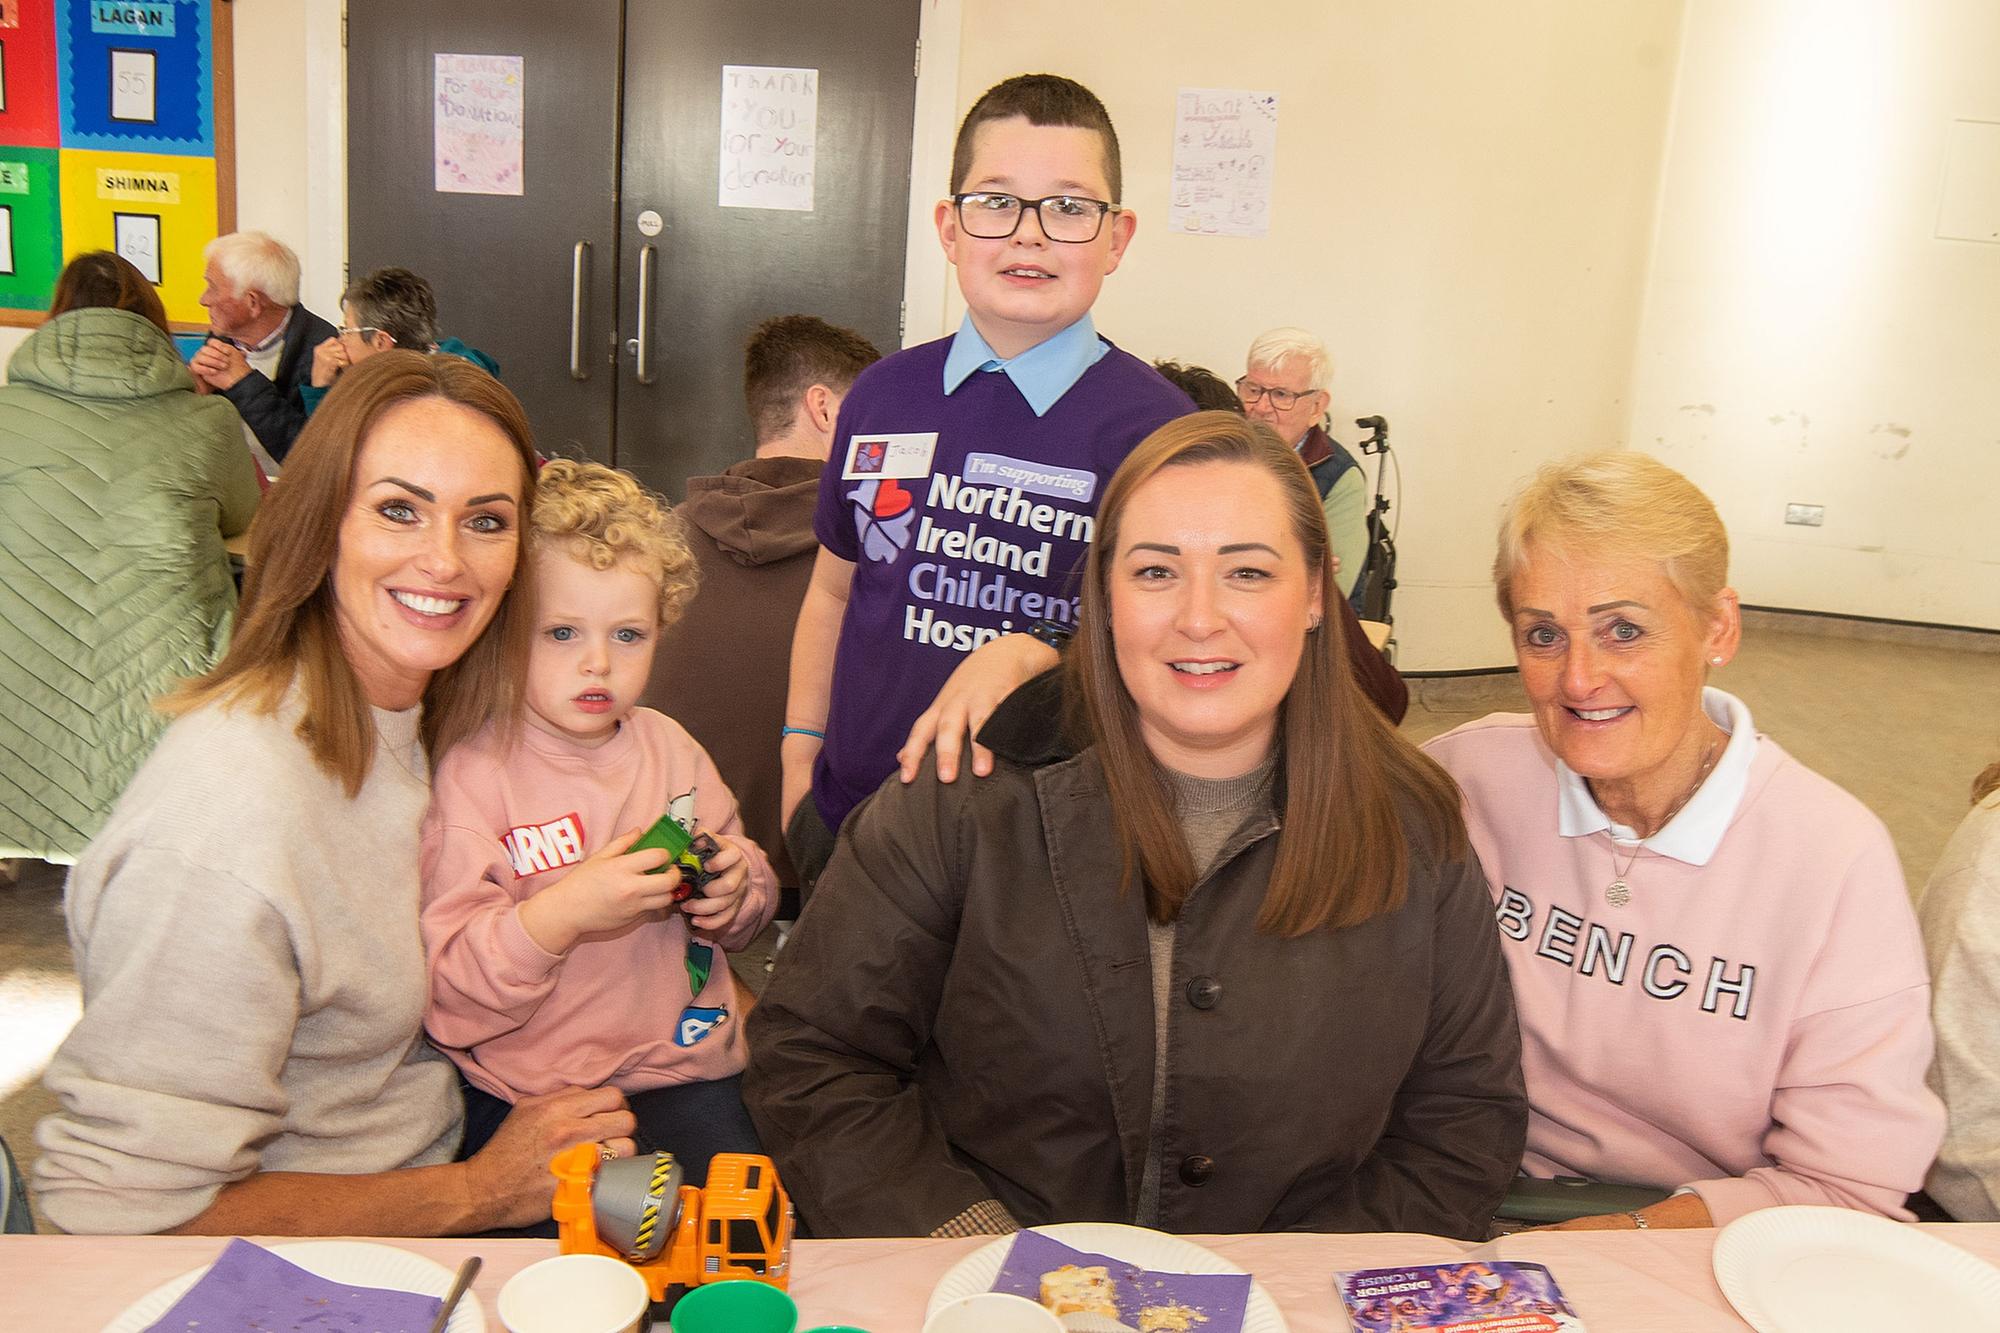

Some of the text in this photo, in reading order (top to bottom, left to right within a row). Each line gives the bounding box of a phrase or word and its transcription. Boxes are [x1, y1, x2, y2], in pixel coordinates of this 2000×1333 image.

[99, 7, 163, 26] LAGAN
[118, 71, 147, 95] 55
[105, 176, 170, 194] SHIMNA
[125, 235, 153, 257] 62
[889, 442, 928, 459] Jacob
[969, 458, 1089, 496] I'm supporting
[926, 472, 1096, 543] Northern
[915, 516, 1053, 577] Ireland
[1495, 885, 1756, 1020] BENCH
[1355, 1280, 1433, 1298] DASH FOR
[1356, 1274, 1407, 1287] CAUSE
